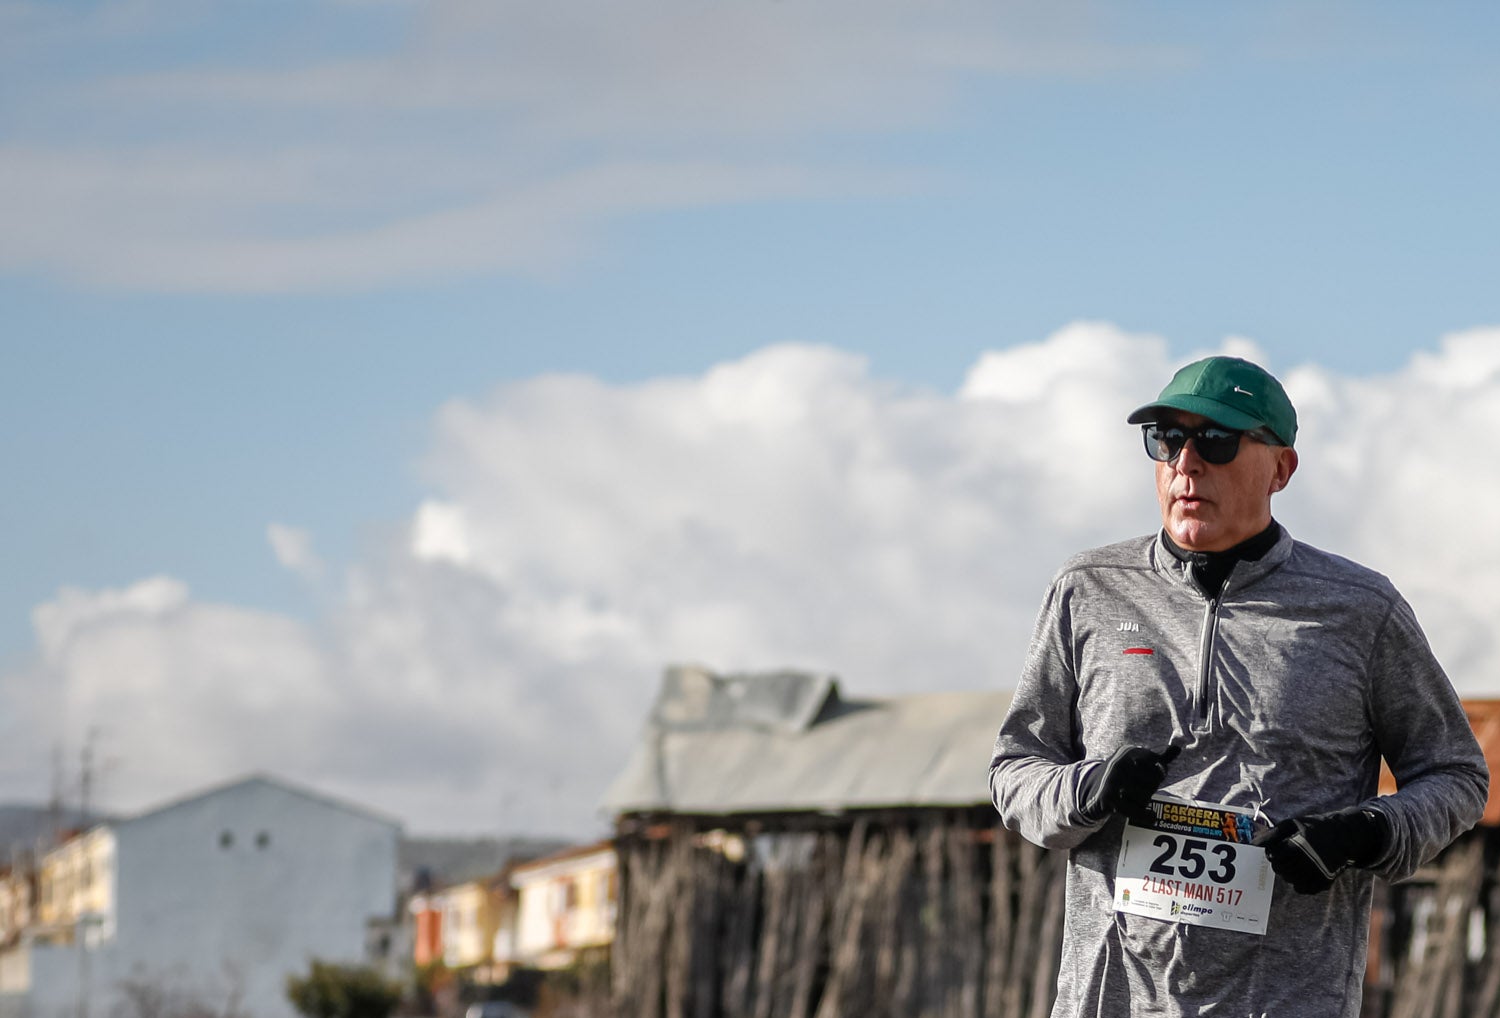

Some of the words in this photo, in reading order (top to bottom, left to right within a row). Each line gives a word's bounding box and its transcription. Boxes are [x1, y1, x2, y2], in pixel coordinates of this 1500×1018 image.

[1163, 804, 1220, 820] CARRERA
[1160, 820, 1192, 832] Secaderos
[1162, 813, 1220, 828] POPULAR
[1149, 834, 1237, 884] 253
[1142, 875, 1149, 892] 2
[1152, 877, 1182, 901] LAST
[1184, 882, 1213, 902] MAN
[1216, 889, 1243, 906] 517
[1182, 904, 1213, 915] olimpo
